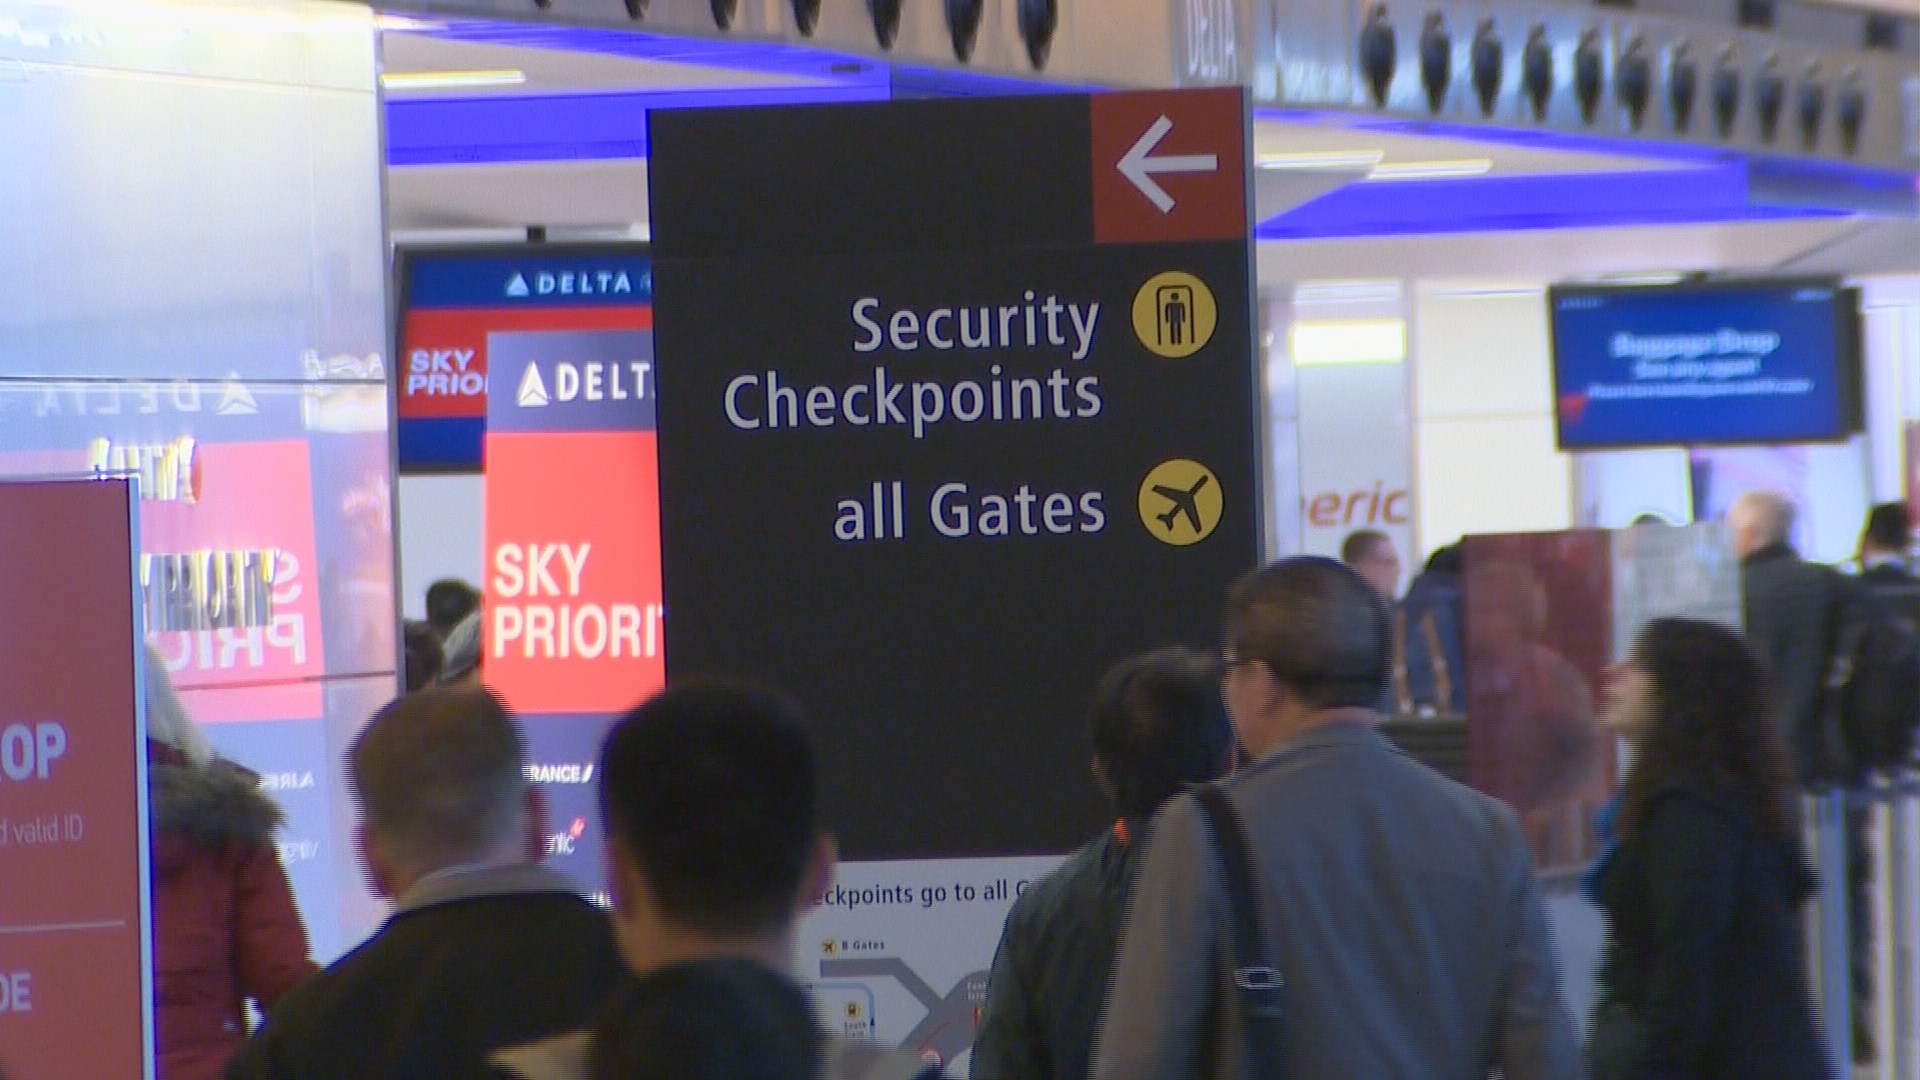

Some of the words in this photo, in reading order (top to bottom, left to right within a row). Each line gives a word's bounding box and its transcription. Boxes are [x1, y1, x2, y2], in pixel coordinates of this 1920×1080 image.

[537, 270, 631, 296] DELTA
[851, 290, 1100, 361] Security
[409, 348, 475, 373] SKY
[556, 360, 655, 403] DELT
[723, 364, 1103, 439] Checkpoints
[833, 481, 905, 541] all
[929, 481, 1107, 538] Gates
[1300, 479, 1408, 526] eric
[494, 541, 592, 599] SKY
[494, 602, 663, 660] PRIORI
[0, 722, 68, 781] OP
[528, 763, 581, 784] RANCE
[13, 816, 58, 845] valid
[64, 813, 84, 841] ID
[921, 886, 946, 908] go
[954, 883, 976, 902] to
[983, 879, 1008, 900] all
[853, 940, 885, 952] Gates
